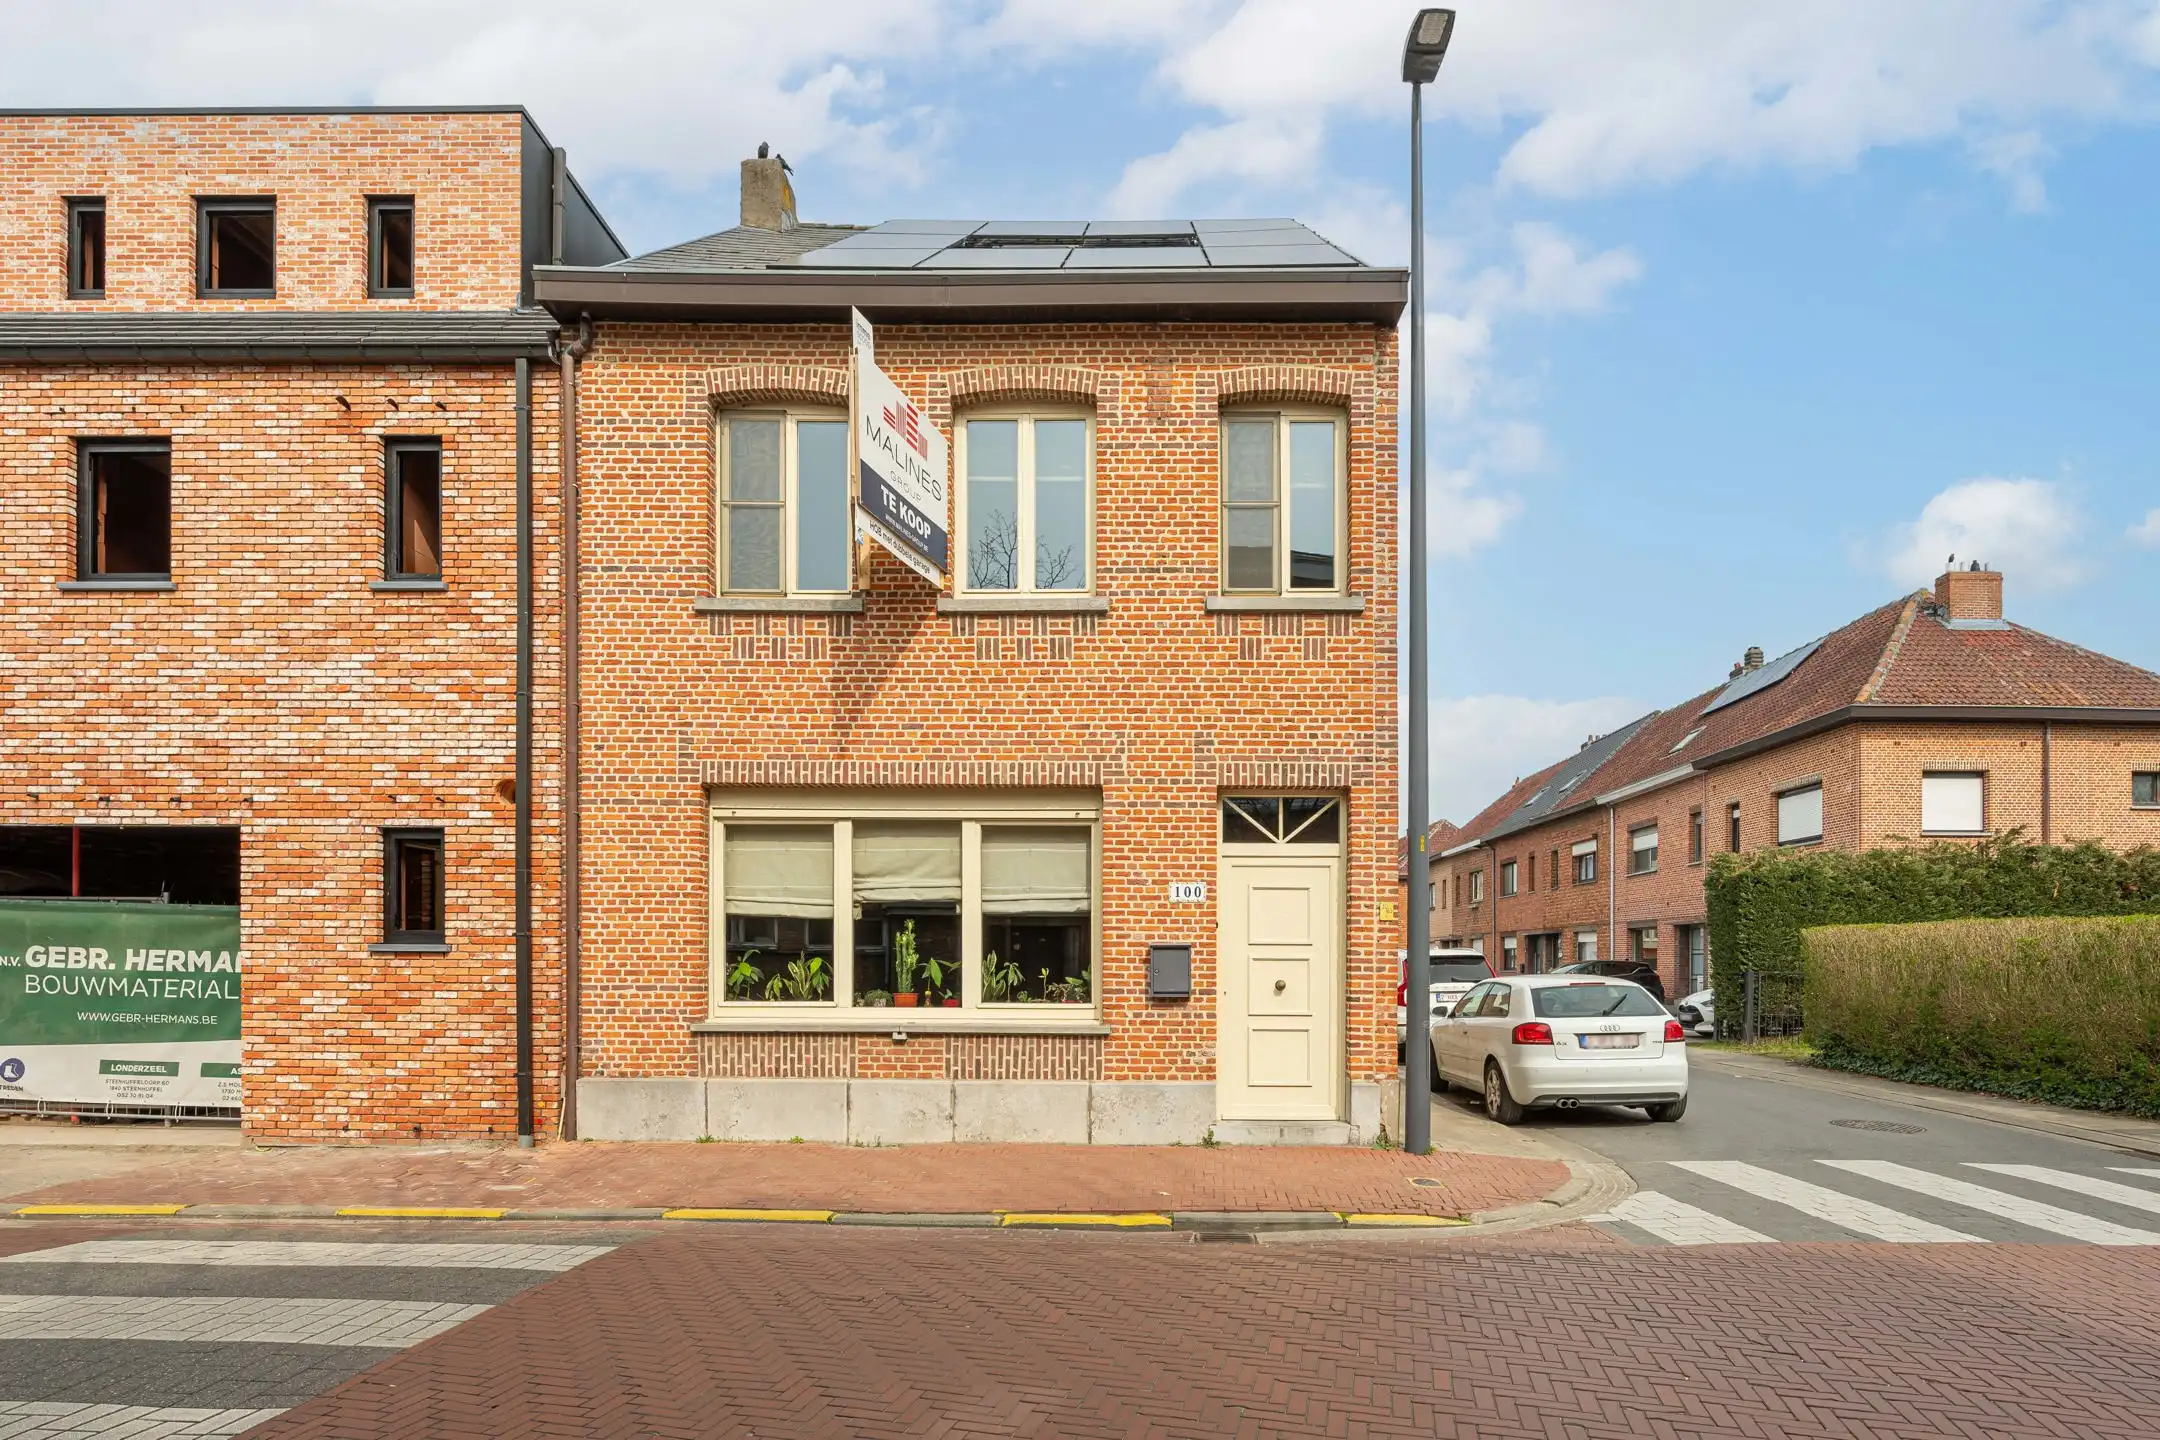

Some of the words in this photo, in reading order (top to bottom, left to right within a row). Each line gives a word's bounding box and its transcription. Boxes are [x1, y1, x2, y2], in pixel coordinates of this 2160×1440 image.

[866, 414, 942, 501] MALINES
[890, 470, 922, 501] GROUP
[881, 484, 897, 514] TE
[899, 500, 931, 539] KOOP
[913, 556, 931, 574] garage
[1175, 886, 1202, 898] 100
[25, 945, 116, 970] GEBR.
[25, 974, 240, 1000] BOUWMATERIAL
[77, 1011, 218, 1025] WWW.GEBR-HERMANS.BE
[111, 1064, 168, 1073] LONDERZEEL
